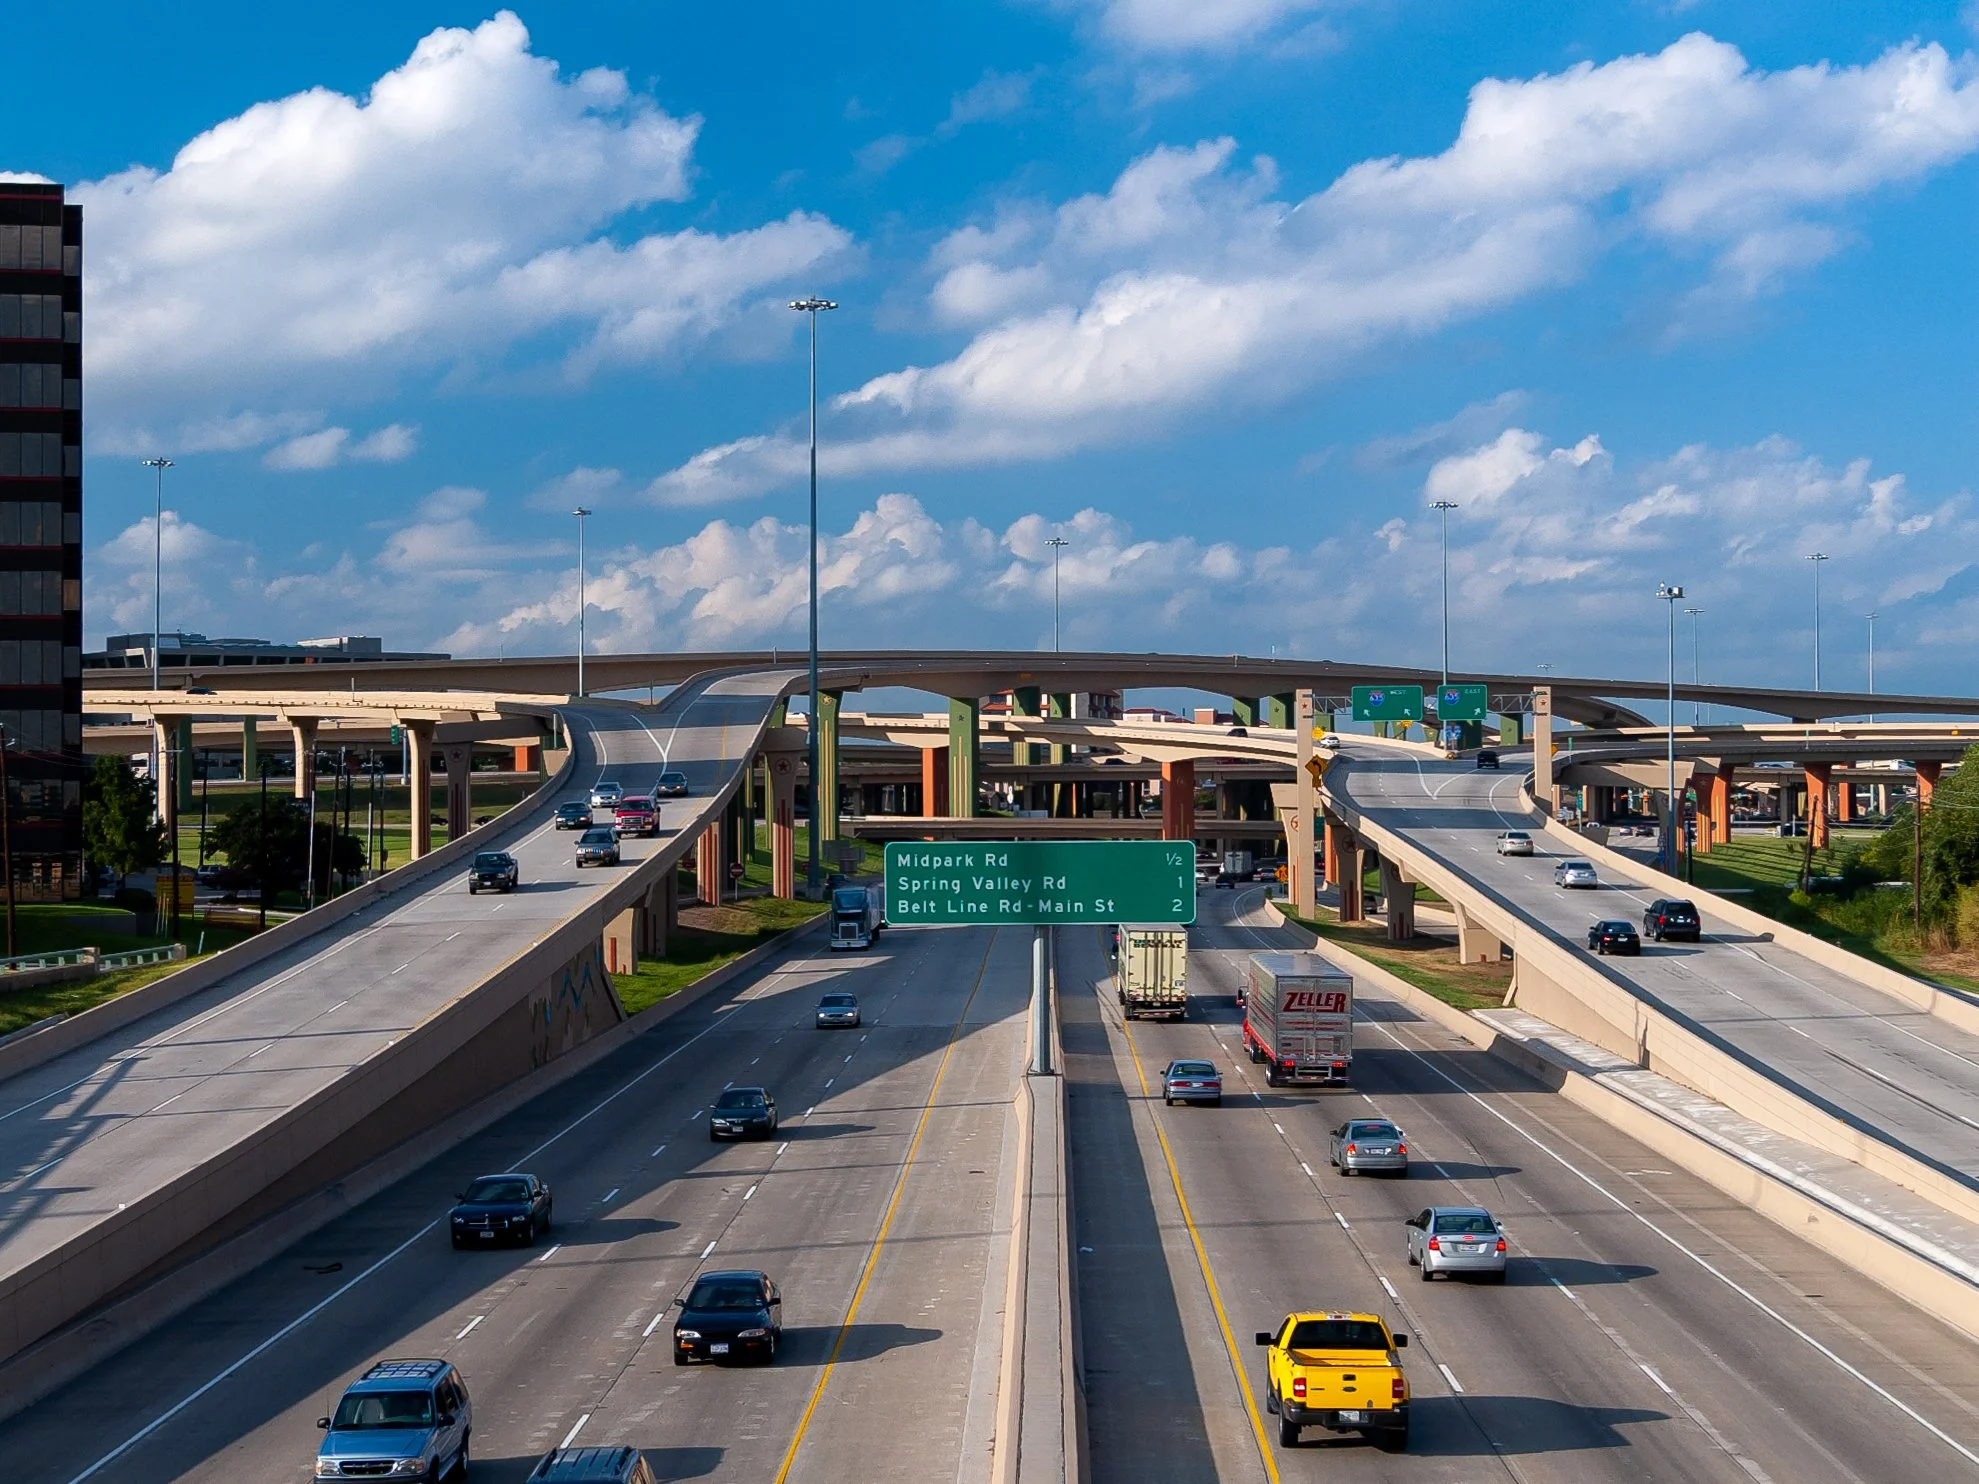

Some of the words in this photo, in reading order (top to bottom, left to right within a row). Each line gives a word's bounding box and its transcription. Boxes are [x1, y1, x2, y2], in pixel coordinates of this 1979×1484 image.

[897, 853, 974, 870] Midpark
[985, 853, 1008, 867] Rd
[898, 876, 961, 894] Spring
[972, 876, 1032, 893] Valley
[1043, 876, 1066, 890] Rd
[1177, 876, 1183, 889] 1
[898, 899, 936, 913] Belt
[947, 899, 989, 913] Line
[1095, 899, 1115, 913] St
[1171, 898, 1183, 912] 2
[1282, 991, 1347, 1013] ZELLER
